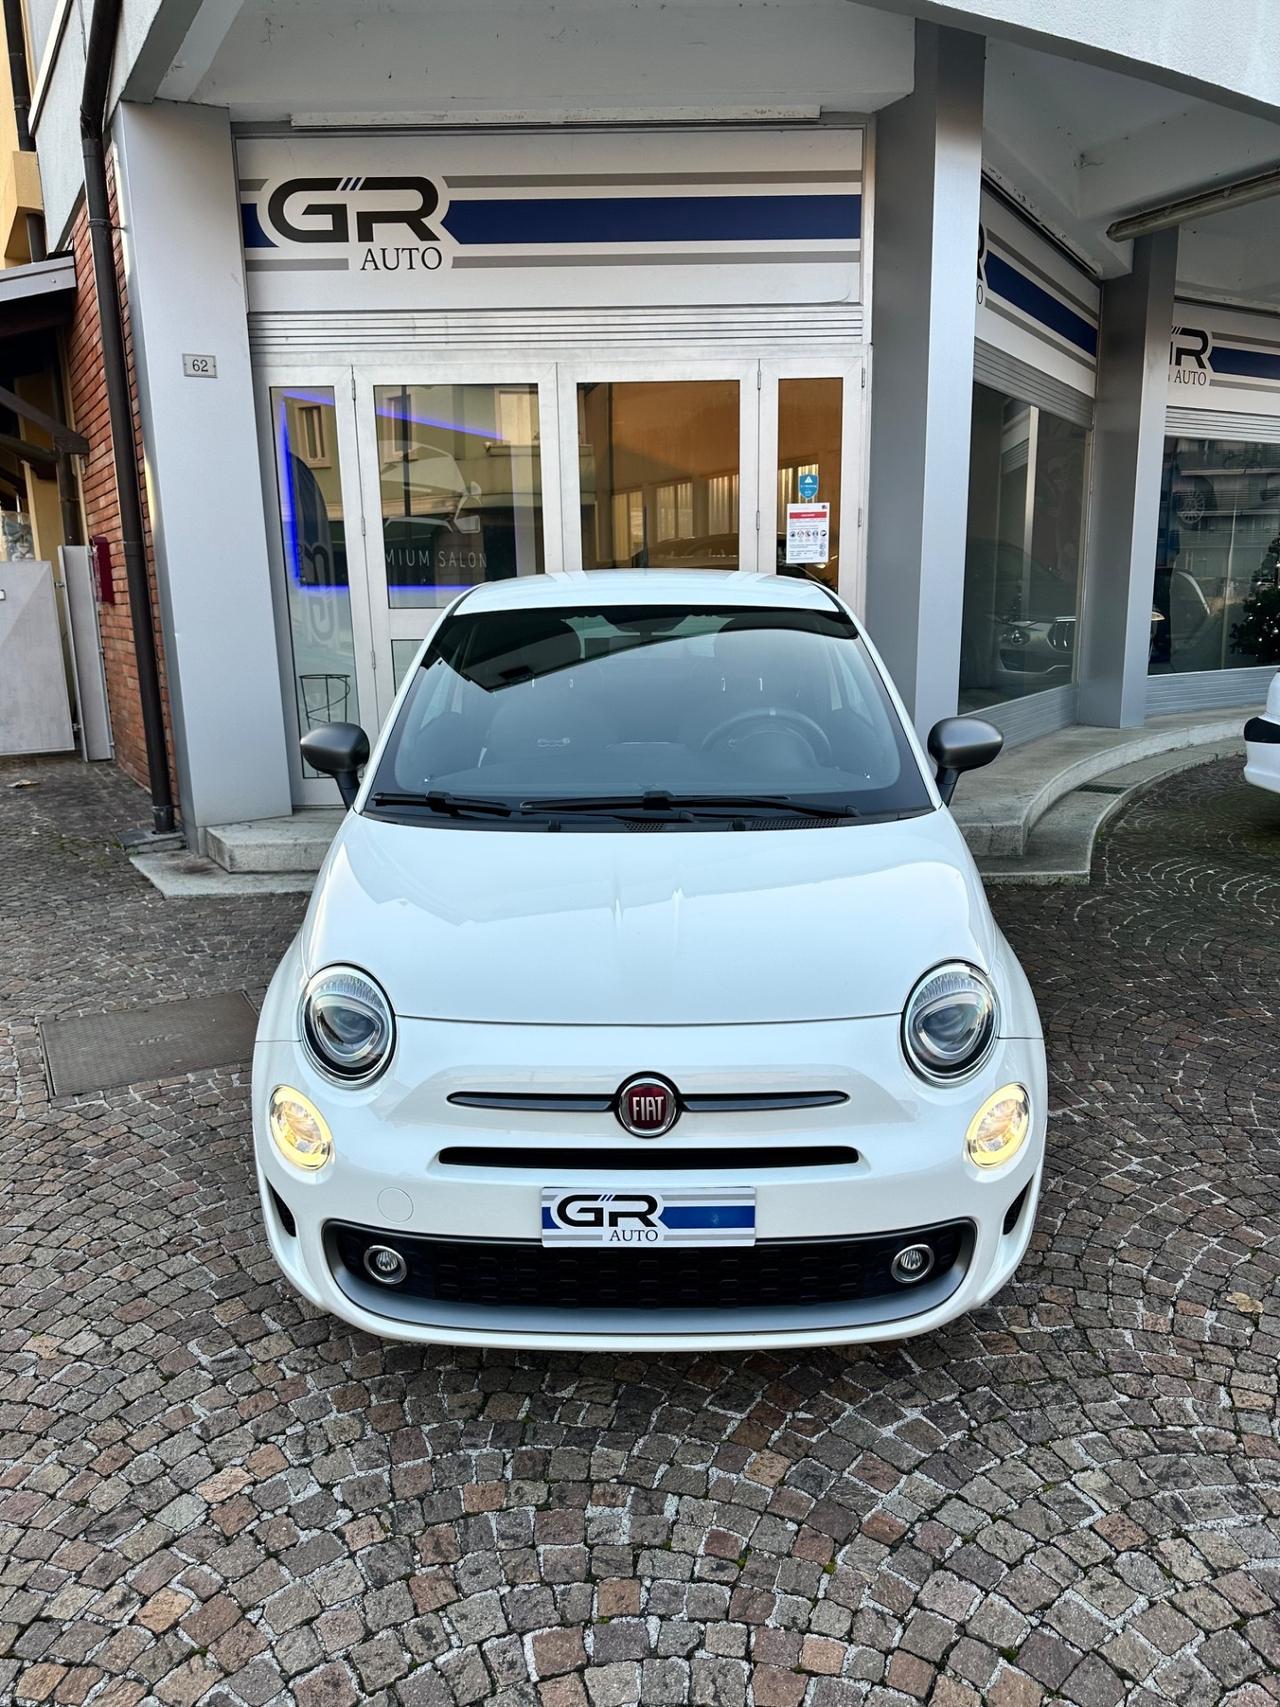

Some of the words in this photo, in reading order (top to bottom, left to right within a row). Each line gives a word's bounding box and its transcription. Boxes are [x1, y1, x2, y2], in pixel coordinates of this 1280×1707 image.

[268, 176, 441, 243] GR
[360, 247, 442, 271] AUTO
[1169, 325, 1209, 369] R
[192, 359, 209, 372] 62
[1174, 369, 1207, 386] AUTO
[438, 550, 487, 568] SALON
[632, 1097, 664, 1121] FIAT
[557, 1194, 658, 1228] GR
[609, 1230, 658, 1242] AUTO
